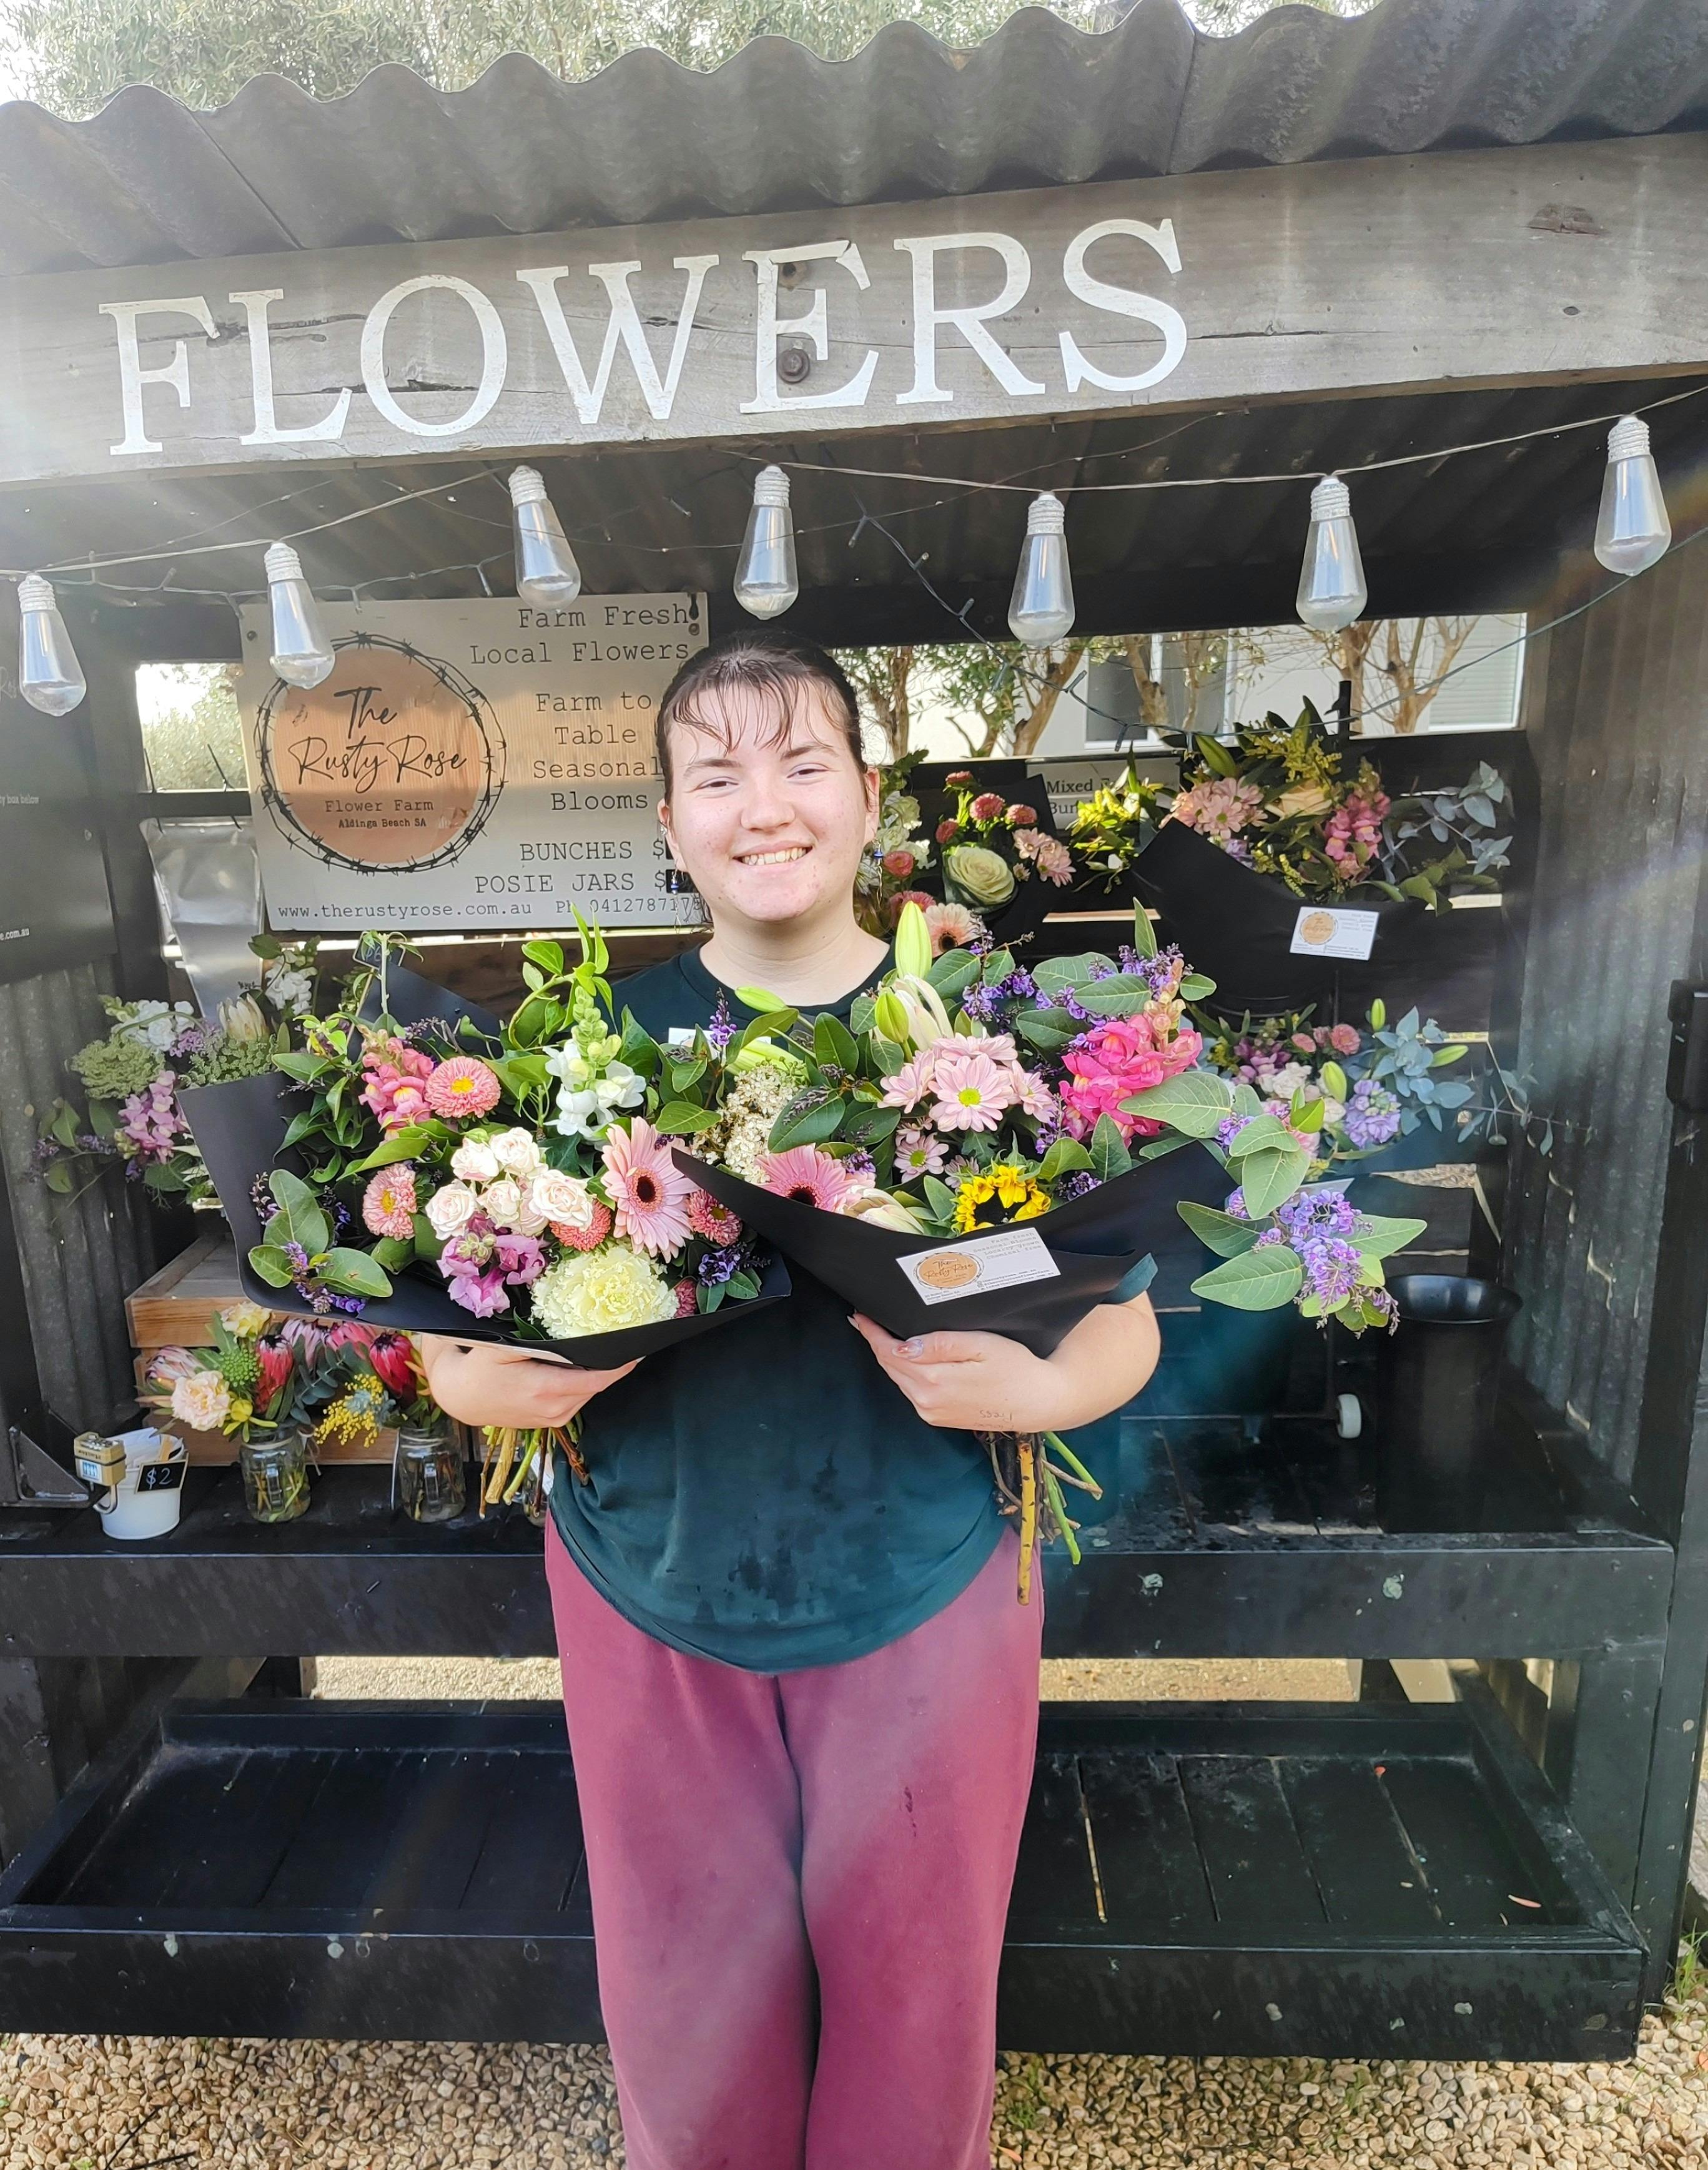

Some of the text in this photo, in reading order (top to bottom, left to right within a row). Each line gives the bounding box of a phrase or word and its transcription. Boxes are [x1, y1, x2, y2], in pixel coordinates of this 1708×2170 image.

[99, 219, 1187, 456] FLOWERS
[518, 603, 689, 628] Farm Fresh
[470, 641, 689, 665] Local Flowers
[333, 687, 398, 739] The
[536, 691, 652, 713] Farm to
[555, 724, 637, 746] Table
[288, 734, 467, 794] Rusty Rose
[533, 756, 663, 779] Seasonal
[1047, 777, 1093, 794] Mixed
[325, 799, 434, 812] Flower Farm
[551, 791, 648, 811] Blooms
[338, 818, 427, 829] Aldinga Beach SA
[520, 841, 632, 862] BUNCHES
[475, 874, 553, 894] POSIE
[572, 873, 634, 892] JARS
[278, 901, 532, 921] www.therustyrose.com.au
[146, 1467, 173, 1491] $2
